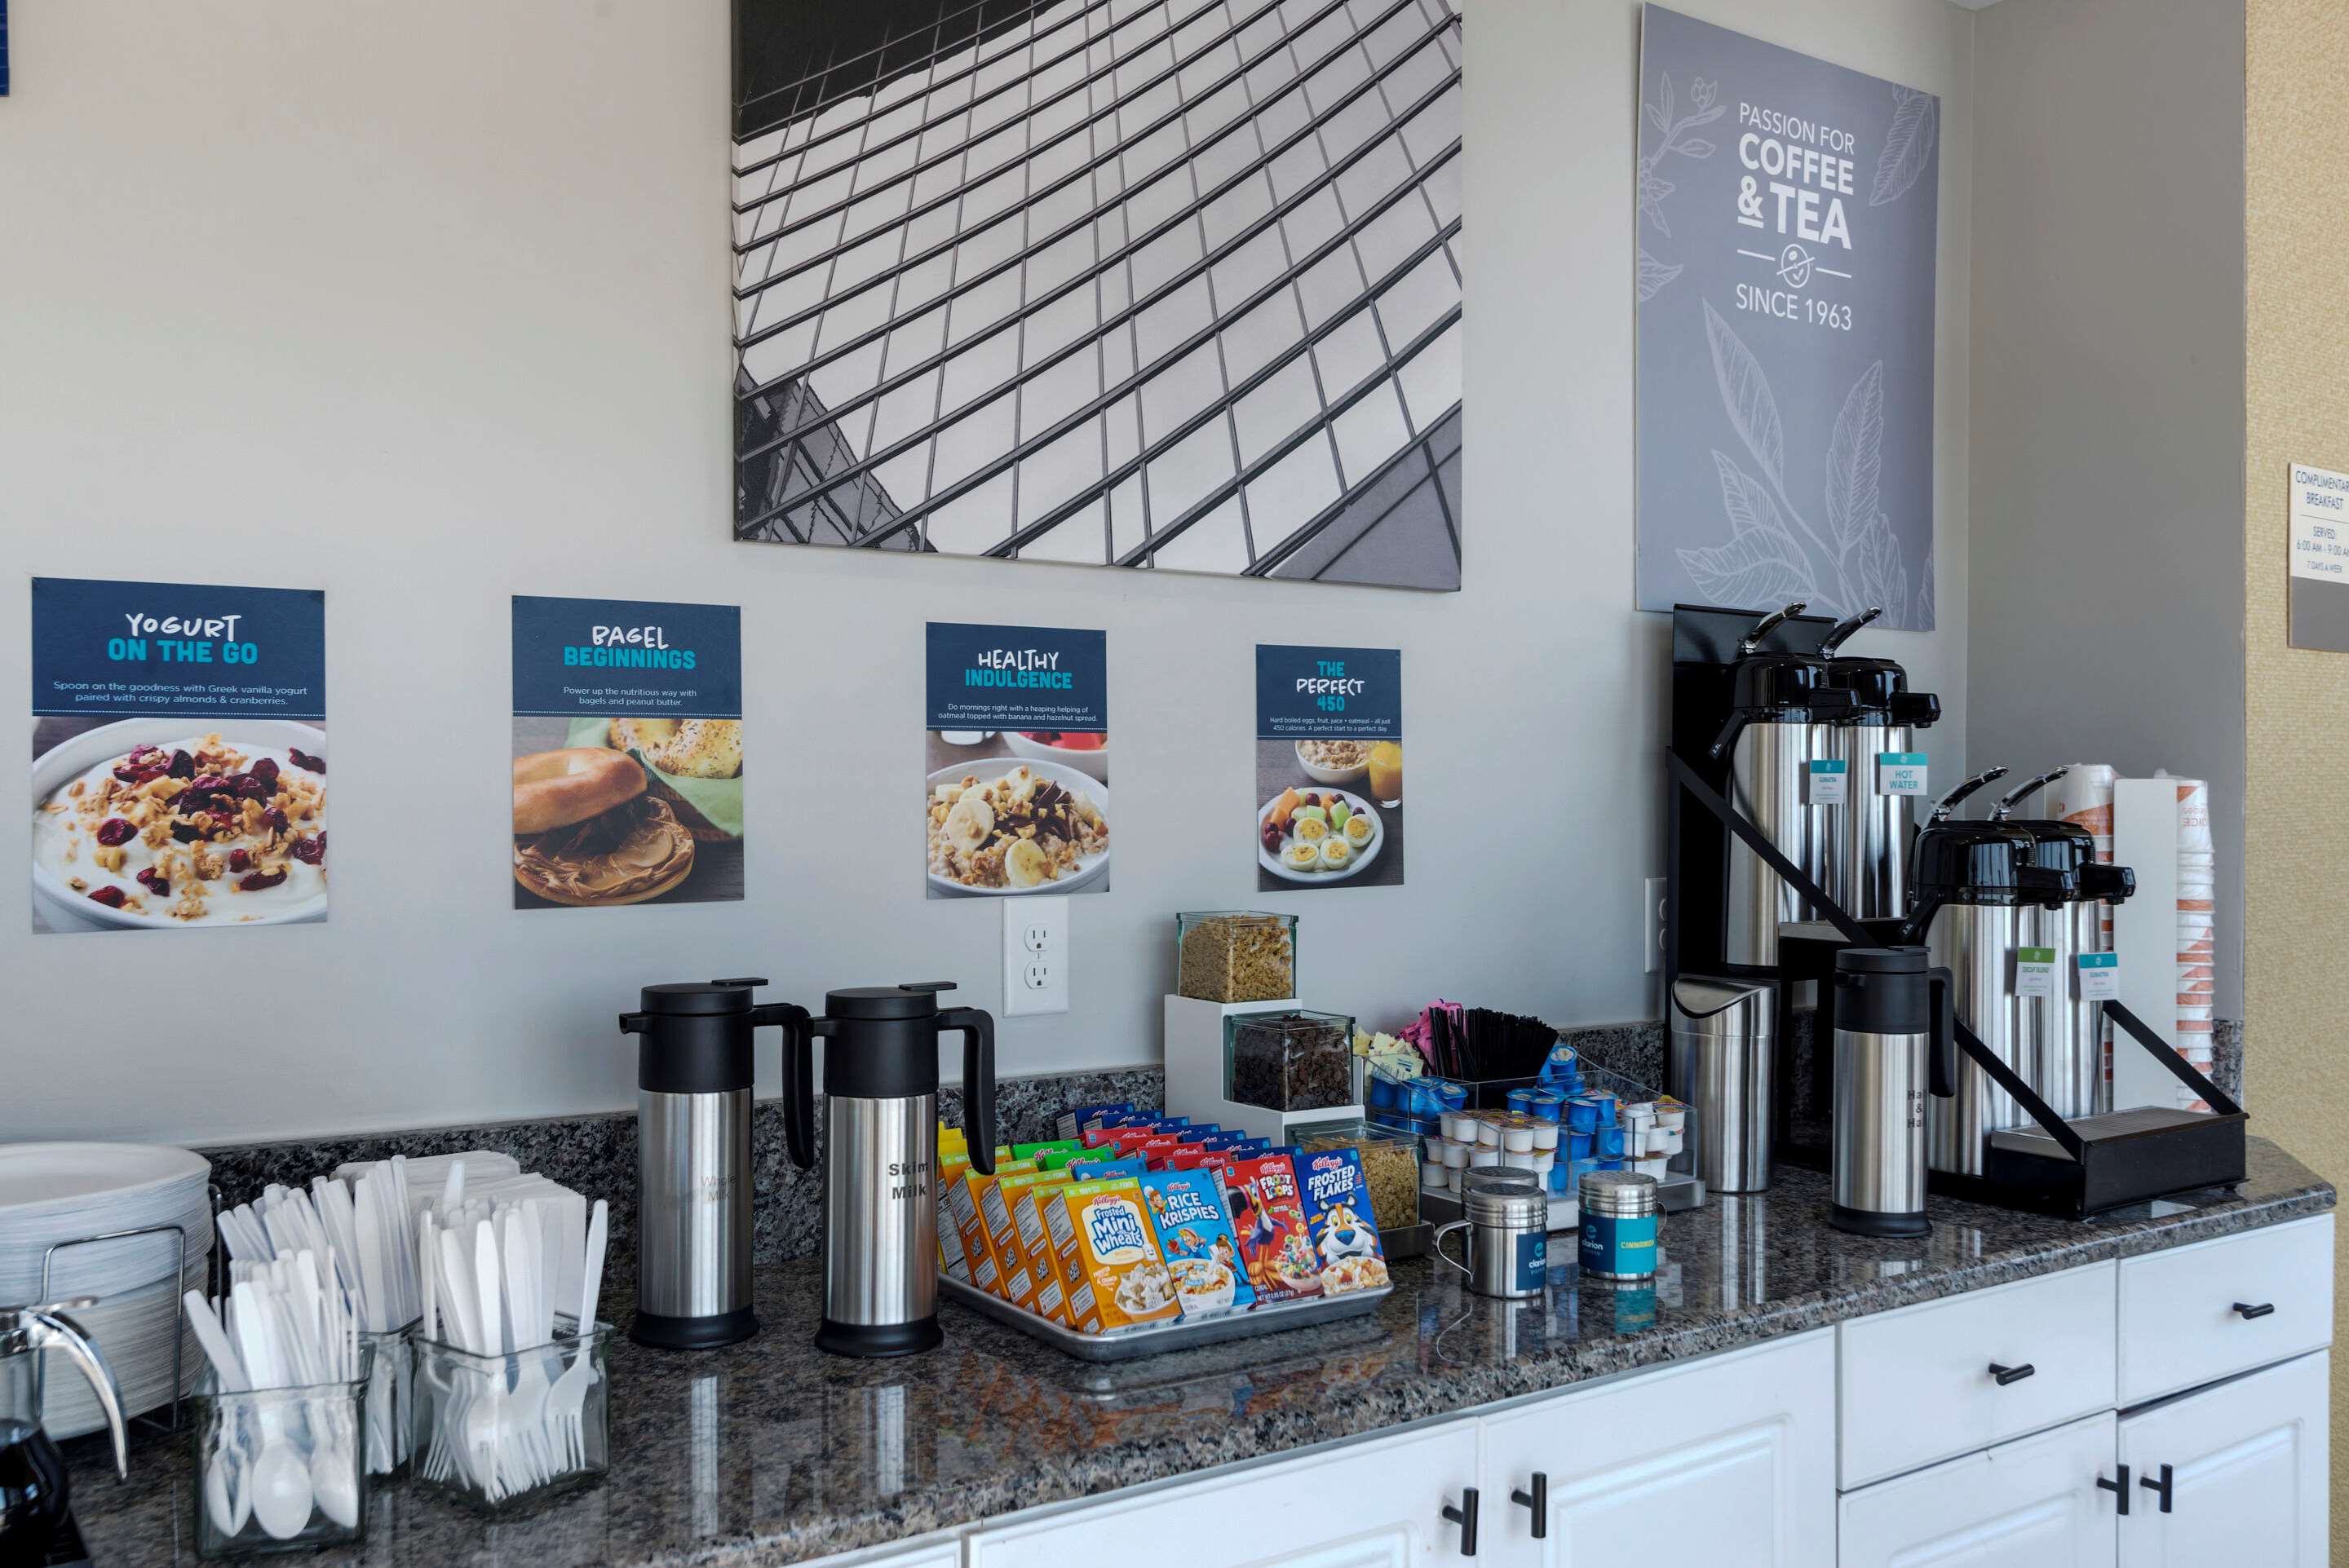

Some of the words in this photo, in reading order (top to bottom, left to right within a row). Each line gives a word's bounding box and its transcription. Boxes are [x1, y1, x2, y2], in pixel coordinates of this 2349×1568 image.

[1740, 102, 1815, 144] PASSION
[1820, 126, 1855, 155] FOR
[1739, 132, 1854, 196] COFFEE
[1737, 175, 1764, 219] &
[1769, 181, 1852, 250] TEA
[1736, 283, 1798, 320] SINCE
[1806, 298, 1852, 331] 1963
[2306, 492, 2343, 510] BREAKFAST
[125, 612, 241, 642] YOGURT
[592, 625, 669, 650] BAGEL
[108, 638, 146, 661] ON
[157, 640, 213, 663] THE
[223, 642, 259, 665] GO
[564, 646, 696, 669] BEGINNINGS
[978, 649, 1059, 671] HEALTHY
[1316, 660, 1345, 677] THE
[965, 669, 1073, 689] INDULGENCE
[1296, 678, 1365, 696] PERFECT
[53, 681, 89, 691] Spoon
[92, 683, 106, 691] on
[108, 682, 126, 691] the
[130, 682, 180, 693] goodness
[183, 683, 206, 693] with
[208, 684, 238, 694] Greek
[241, 685, 272, 695] vanilla
[275, 687, 307, 696] yogurt
[564, 687, 590, 696] Power
[592, 688, 603, 697] up
[605, 687, 619, 696] the
[621, 688, 659, 696] nutritious
[661, 690, 677, 699] way
[679, 689, 697, 697] with
[75, 692, 110, 703] paired
[113, 693, 136, 702] with
[139, 694, 170, 705] crispy
[173, 694, 217, 704] almonds
[219, 695, 227, 704] &
[229, 696, 288, 705] cranberries.
[579, 696, 607, 706] bagels
[608, 697, 624, 705] and
[626, 698, 654, 707] peanut
[657, 698, 683, 706] butter.
[1317, 696, 1345, 712] 450
[948, 703, 958, 711] Do
[959, 704, 991, 713] mornings
[993, 704, 1007, 713] right
[1030, 705, 1056, 713] heaping
[1057, 706, 1080, 714] helping
[967, 713, 991, 721] topped
[1046, 713, 1074, 722] hazelnut
[1895, 770, 1913, 780] HOT
[1890, 780, 1918, 789] WATER
[888, 1161, 928, 1176] Skim
[1260, 1162, 1285, 1174] Kellogg's
[1312, 1156, 1343, 1170] Kellogg's
[701, 1174, 737, 1187] Whole
[1259, 1173, 1292, 1190] FROOT
[1308, 1165, 1355, 1190] FROSTED
[708, 1190, 732, 1201] Milk
[892, 1183, 927, 1199] Milk
[1167, 1182, 1191, 1192] Kellogg's
[1265, 1185, 1294, 1200] LOOPS
[1314, 1177, 1353, 1201] FLAKES
[1092, 1195, 1121, 1206] Kellogg's
[1167, 1192, 1201, 1211] RICE
[1095, 1207, 1126, 1221] Frosted
[1160, 1205, 1219, 1230] KRISPIES
[1094, 1216, 1135, 1239] Mini
[1095, 1230, 1144, 1254] Wheats
